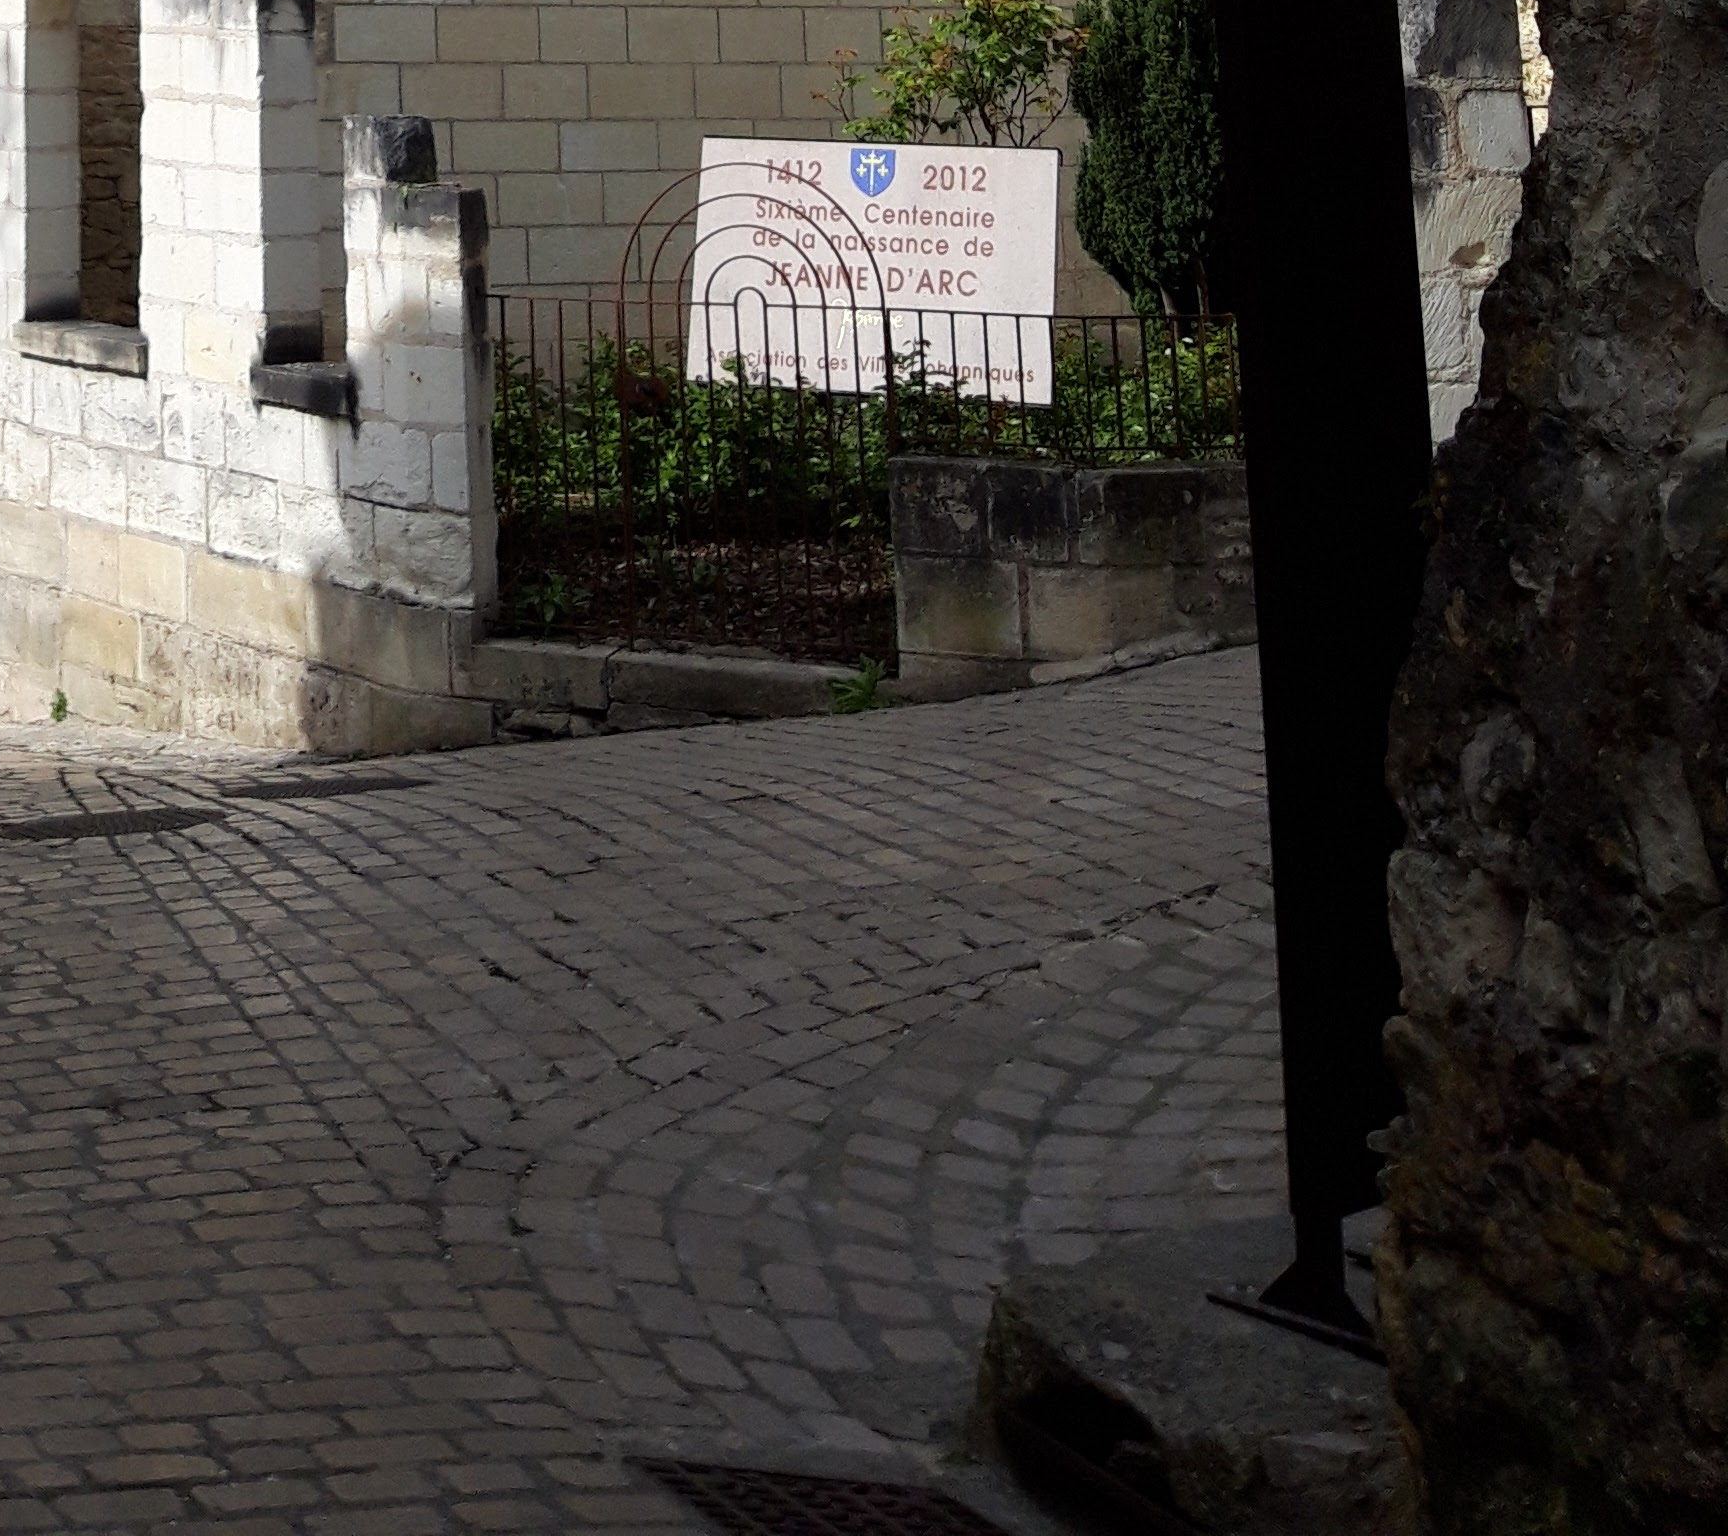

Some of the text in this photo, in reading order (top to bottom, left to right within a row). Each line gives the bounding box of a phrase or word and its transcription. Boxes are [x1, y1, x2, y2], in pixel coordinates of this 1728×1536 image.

[766, 158, 987, 192] 1412 2012
[756, 197, 995, 228] Sixième Centenaire
[752, 228, 994, 257] de la naissance de
[765, 260, 978, 297] JEANNE D'ARC
[816, 354, 848, 371] des
